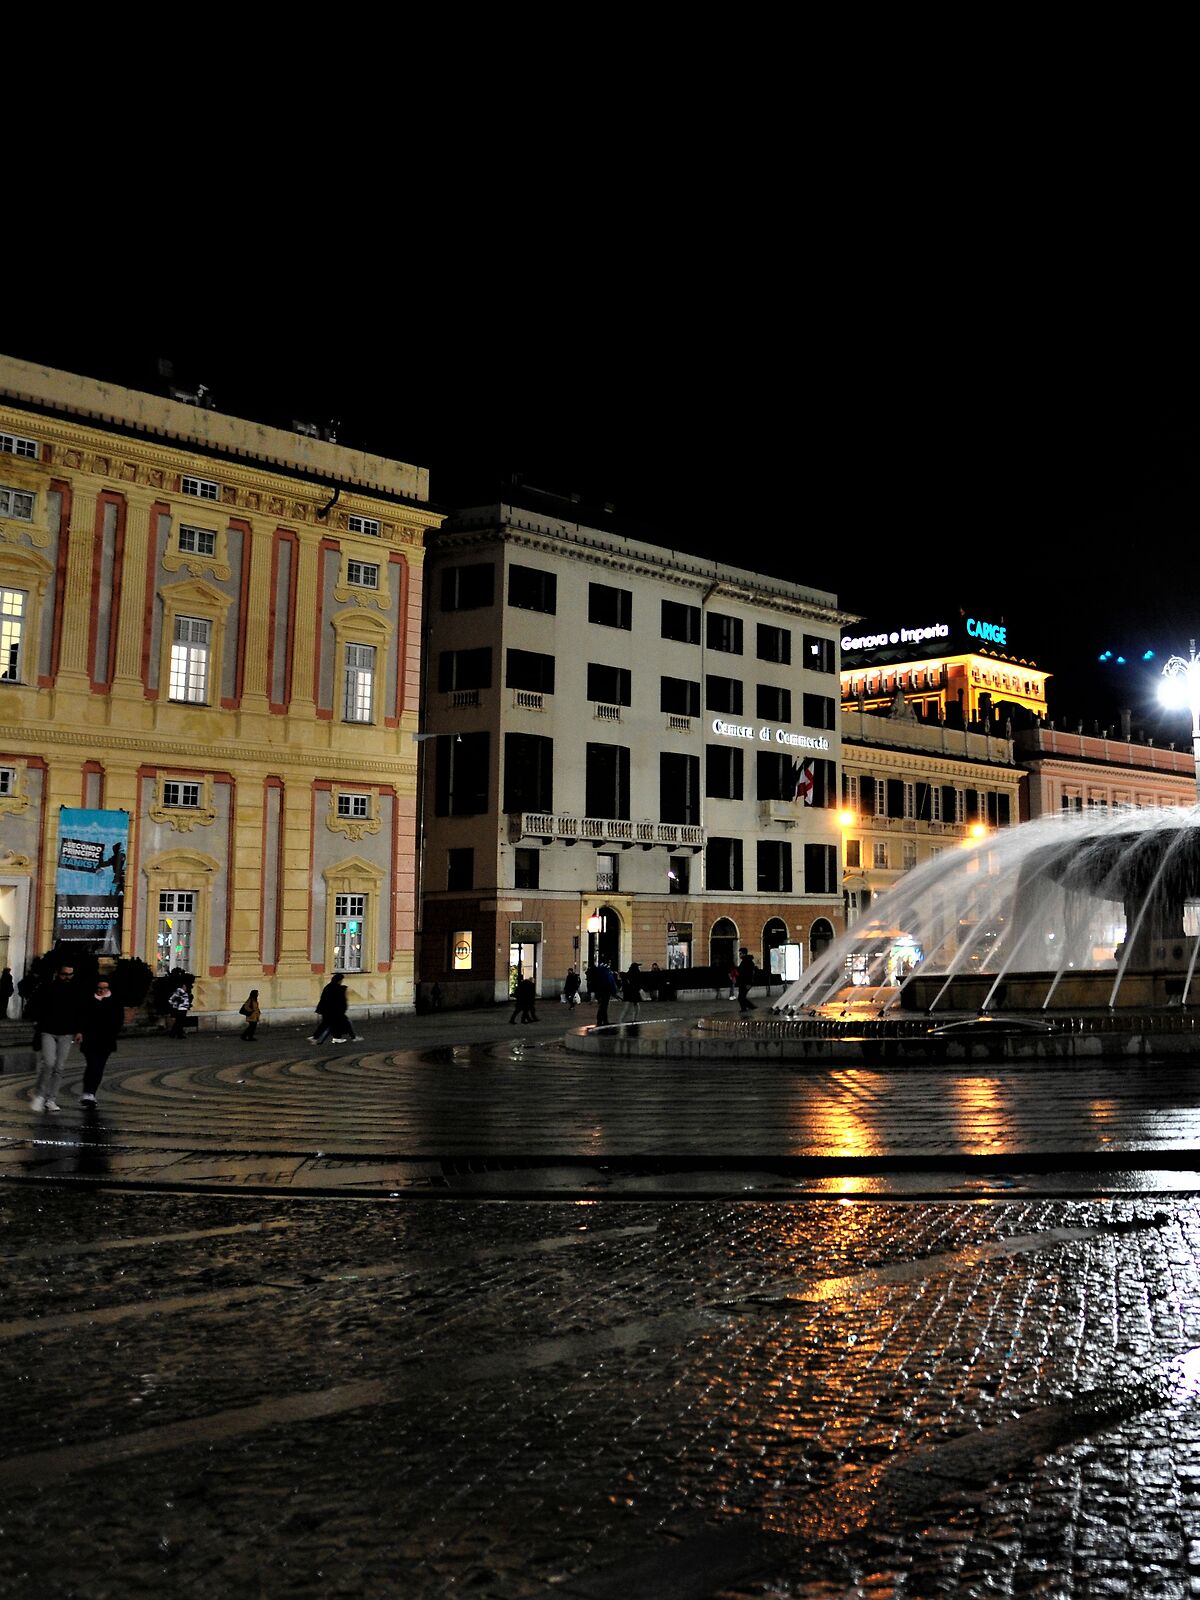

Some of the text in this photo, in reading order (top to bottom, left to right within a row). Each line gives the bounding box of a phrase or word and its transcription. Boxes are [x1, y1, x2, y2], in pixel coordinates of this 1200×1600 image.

[841, 623, 949, 651] Genova e Imperia
[966, 618, 1007, 645] CARIGE
[712, 719, 830, 750] Camera di Commercio
[67, 841, 102, 852] SECONDO
[62, 858, 98, 868] BANKSY
